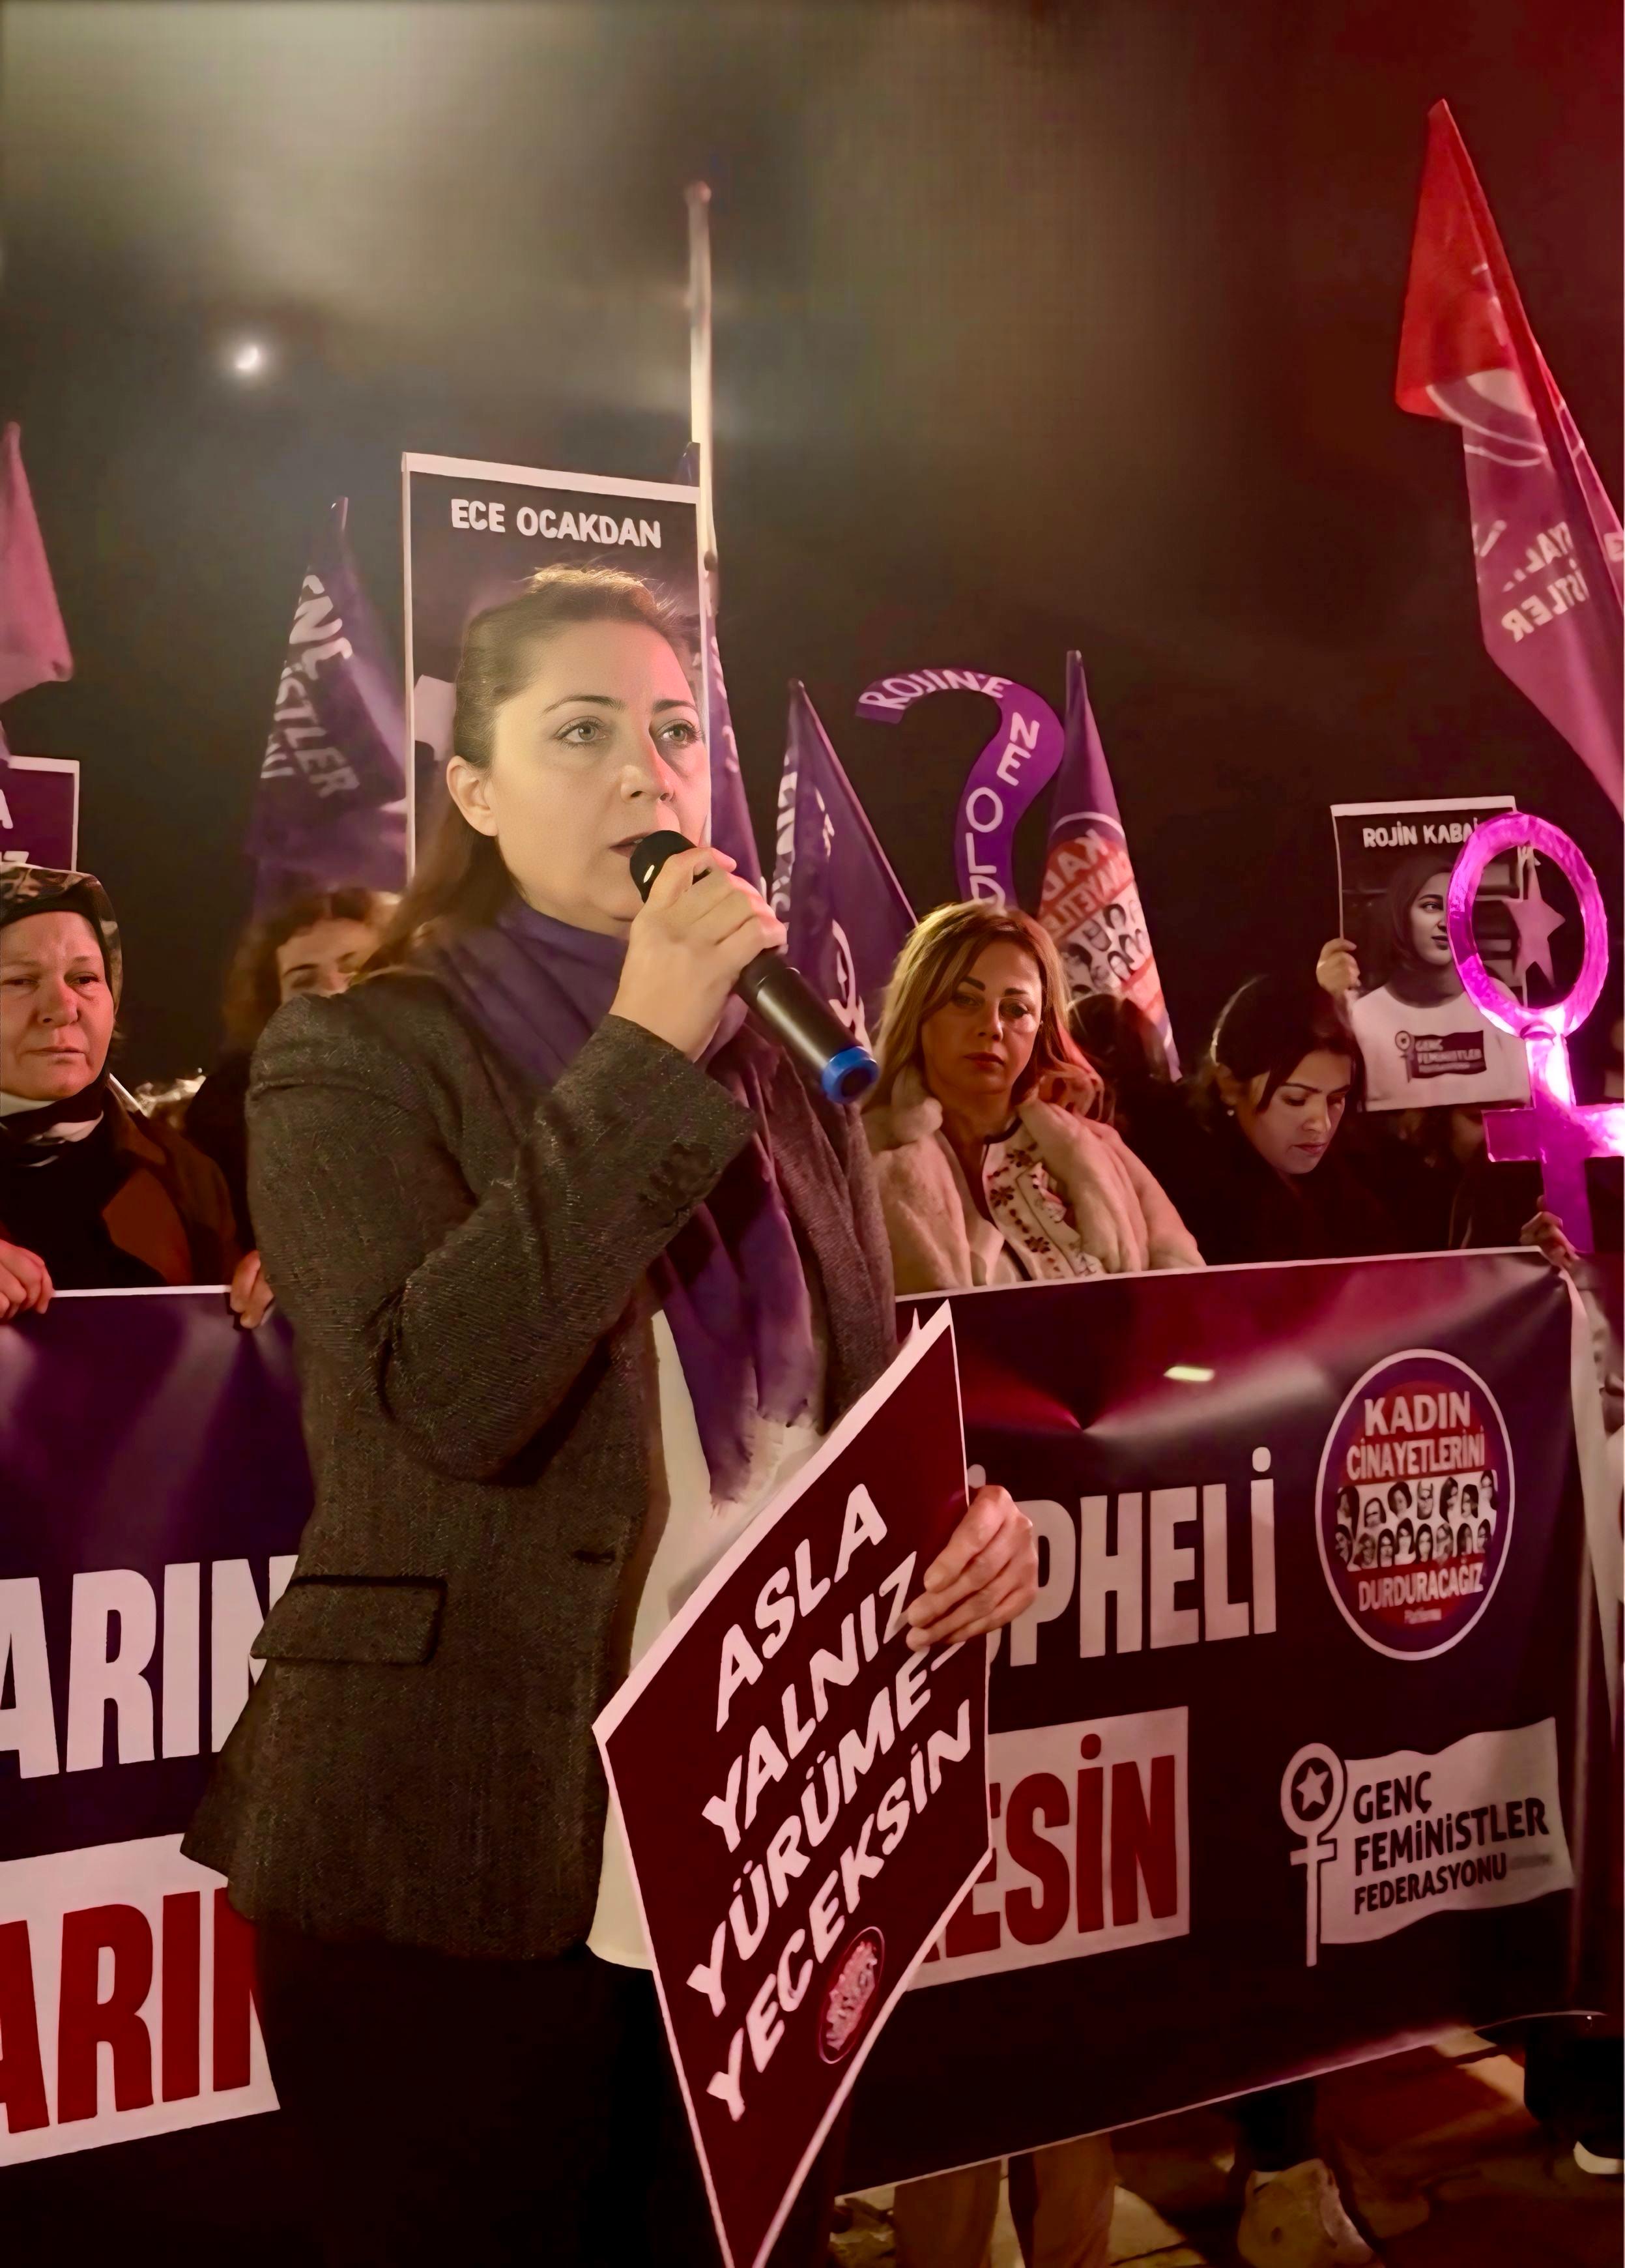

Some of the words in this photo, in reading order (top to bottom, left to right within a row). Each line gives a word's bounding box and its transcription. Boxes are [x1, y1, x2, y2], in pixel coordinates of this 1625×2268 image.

[451, 499, 505, 532] ECE
[517, 506, 661, 548] OCAKDAN
[996, 712, 1041, 787] NE
[1362, 821, 1418, 848] ROJİN
[1423, 817, 1479, 845] KABA
[1364, 1391, 1471, 1436] KADIN
[1346, 1425, 1486, 1481] CİNAYETLERİNİ
[968, 1447, 1276, 1667] PHELİ
[716, 1483, 888, 1733] ASLA
[702, 1551, 917, 1853] YALNIZ
[1353, 1771, 1432, 1824] GENÇ
[920, 1733, 1177, 1963] ESİN
[1355, 1852, 1506, 1902] FEDERASYONU
[706, 1699, 971, 2122] YECEKSİN
